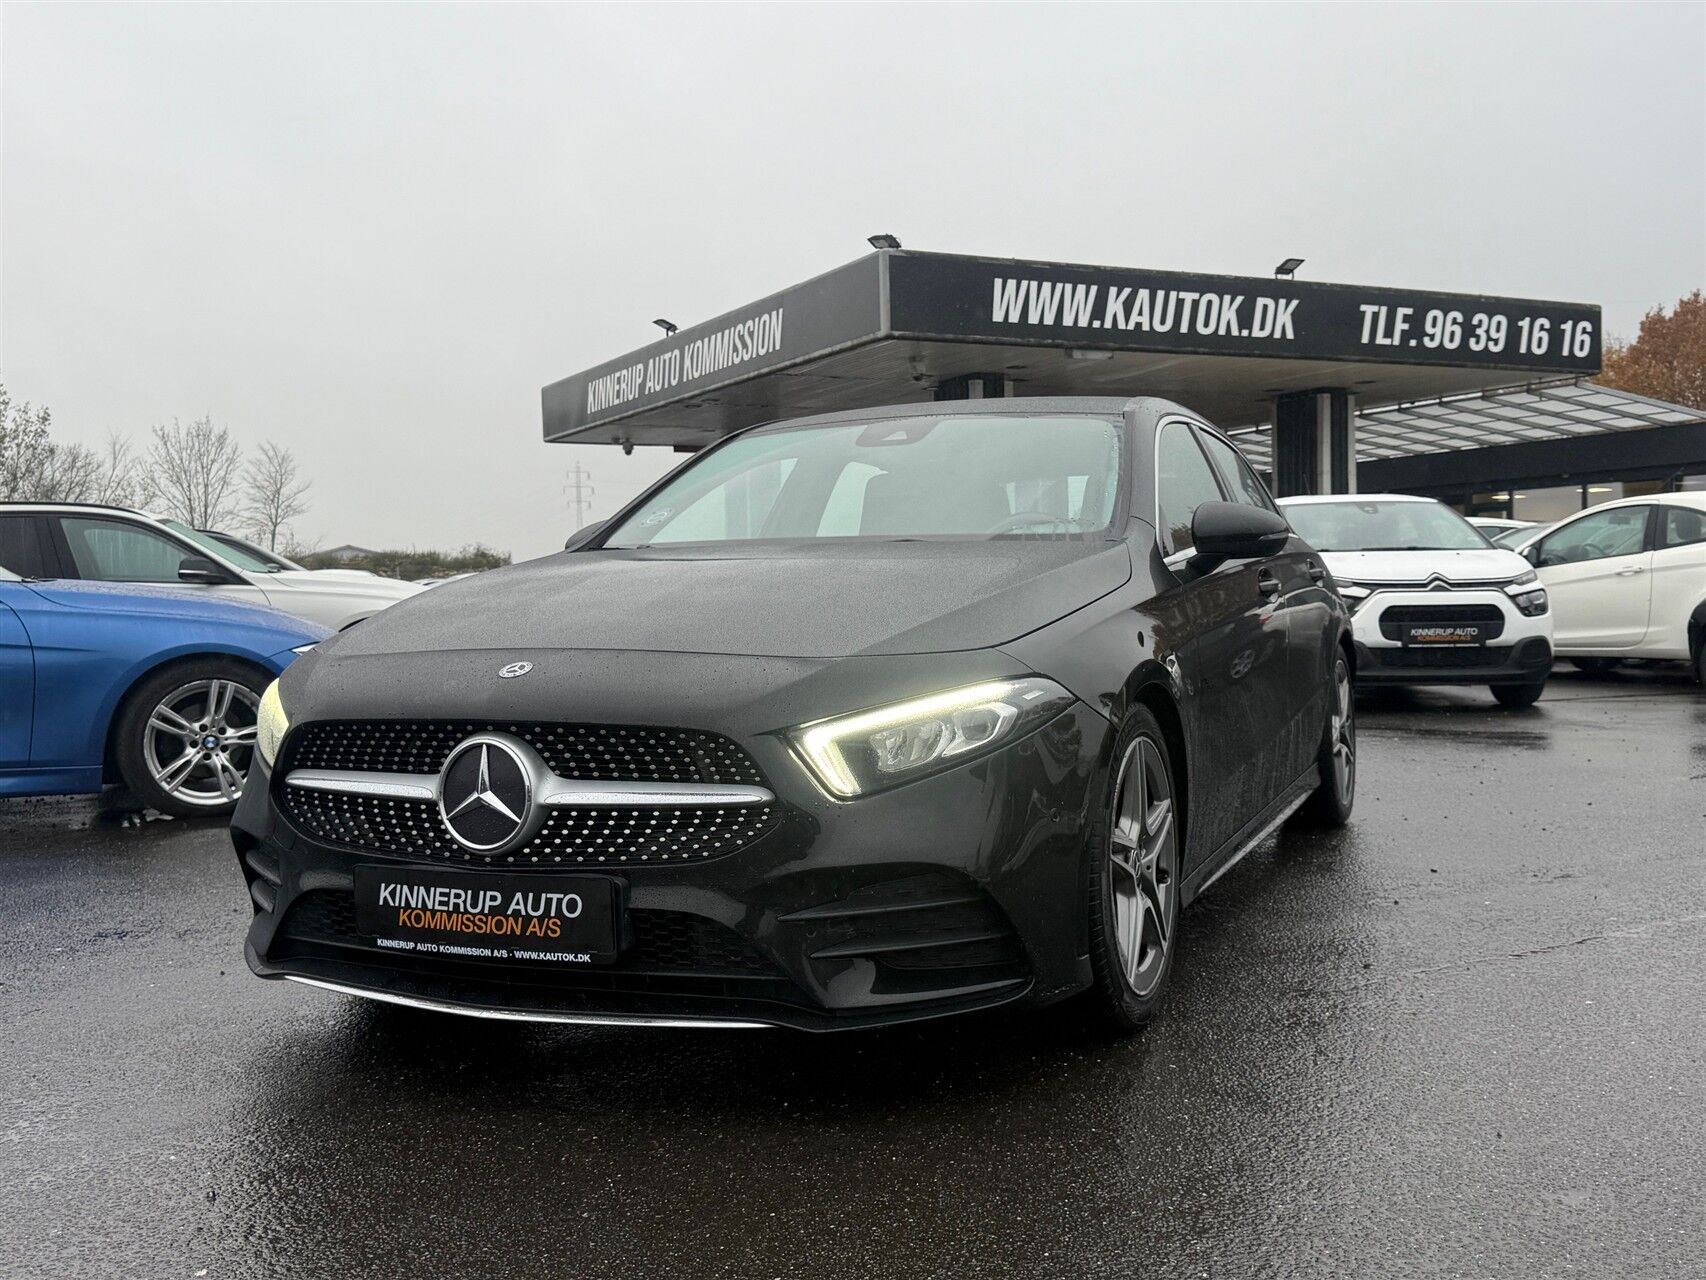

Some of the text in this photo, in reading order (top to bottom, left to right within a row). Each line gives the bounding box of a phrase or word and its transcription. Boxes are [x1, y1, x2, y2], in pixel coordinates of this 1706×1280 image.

[991, 277, 1299, 340] WWW.KAUTOK.DK
[1359, 304, 1593, 358] TLF. 96 39 16 16
[587, 308, 784, 414] KINNERUP AUTO KOMMISSION
[1410, 627, 1478, 636] KINNERUP AUTO
[378, 883, 583, 918] KINNERUP AUTO
[398, 909, 562, 938] KOMMISSION A/S
[377, 938, 415, 950] KINNERUP
[416, 943, 438, 952] AUTO
[439, 944, 492, 957] KOMMISSION
[493, 949, 508, 958] A/S
[513, 950, 592, 963] WWW.KAUTOK.DK
